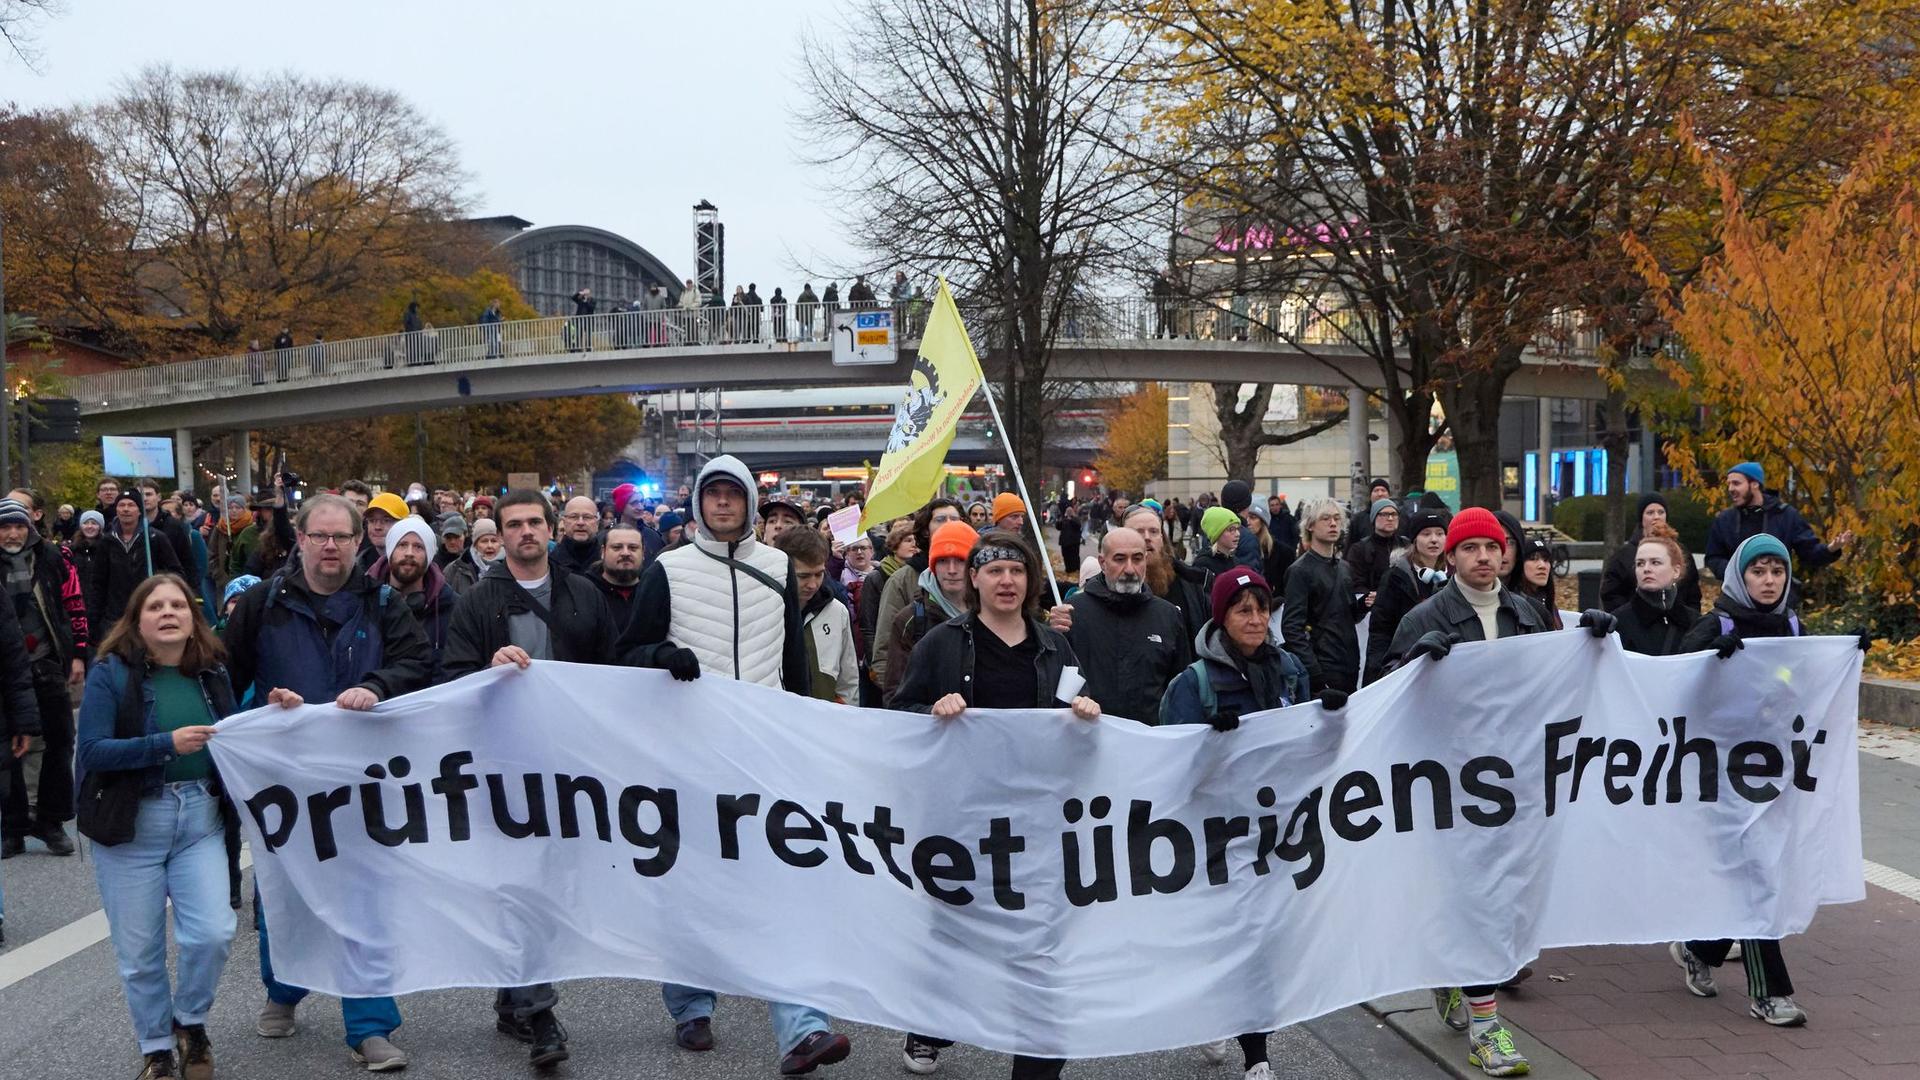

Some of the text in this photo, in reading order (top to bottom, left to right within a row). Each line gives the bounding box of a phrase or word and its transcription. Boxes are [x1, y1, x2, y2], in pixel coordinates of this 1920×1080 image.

[244, 750, 681, 877] prüfung
[716, 793, 1025, 911] rettet
[1061, 756, 1517, 907] übrigens
